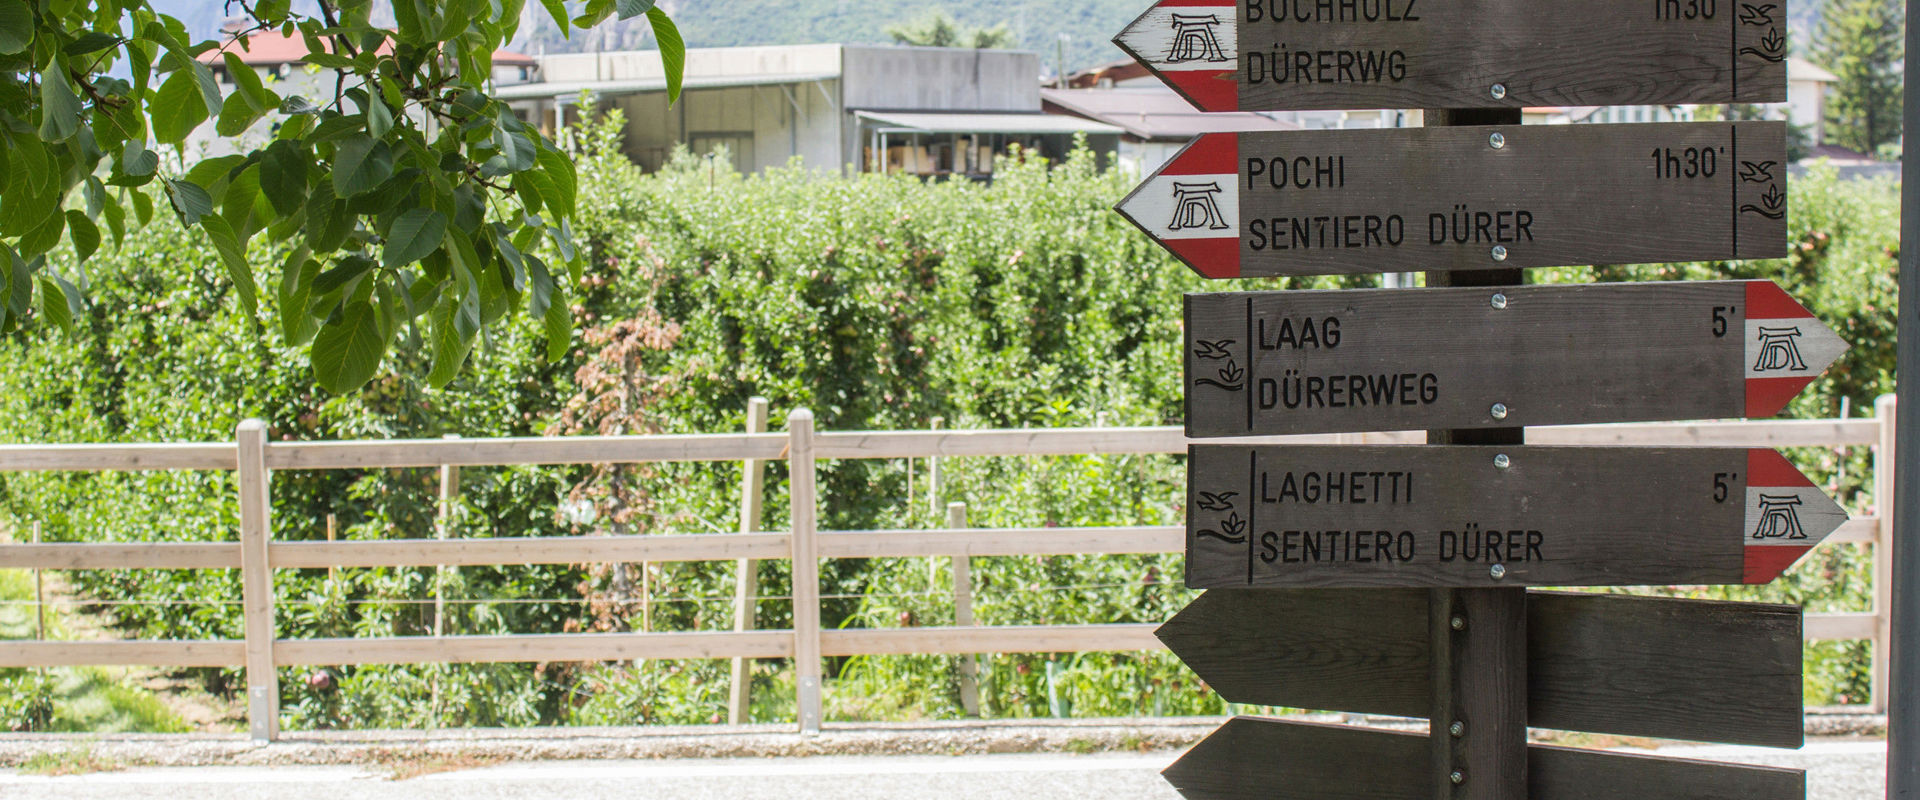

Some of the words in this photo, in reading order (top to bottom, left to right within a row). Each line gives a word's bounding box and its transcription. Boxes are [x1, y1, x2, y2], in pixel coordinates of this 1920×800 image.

[1247, 43, 1406, 84] DÜRERWG
[1247, 155, 1345, 190] POCHI
[1248, 214, 1404, 251] SENTIERO
[1429, 205, 1534, 246] DÜRER
[1258, 317, 1341, 351] LAAG
[1258, 369, 1439, 410] DÜRERWEG
[1261, 471, 1413, 504] LAGHETTI
[1259, 530, 1416, 563] SENTIERO
[1439, 523, 1545, 563] DÜRER
